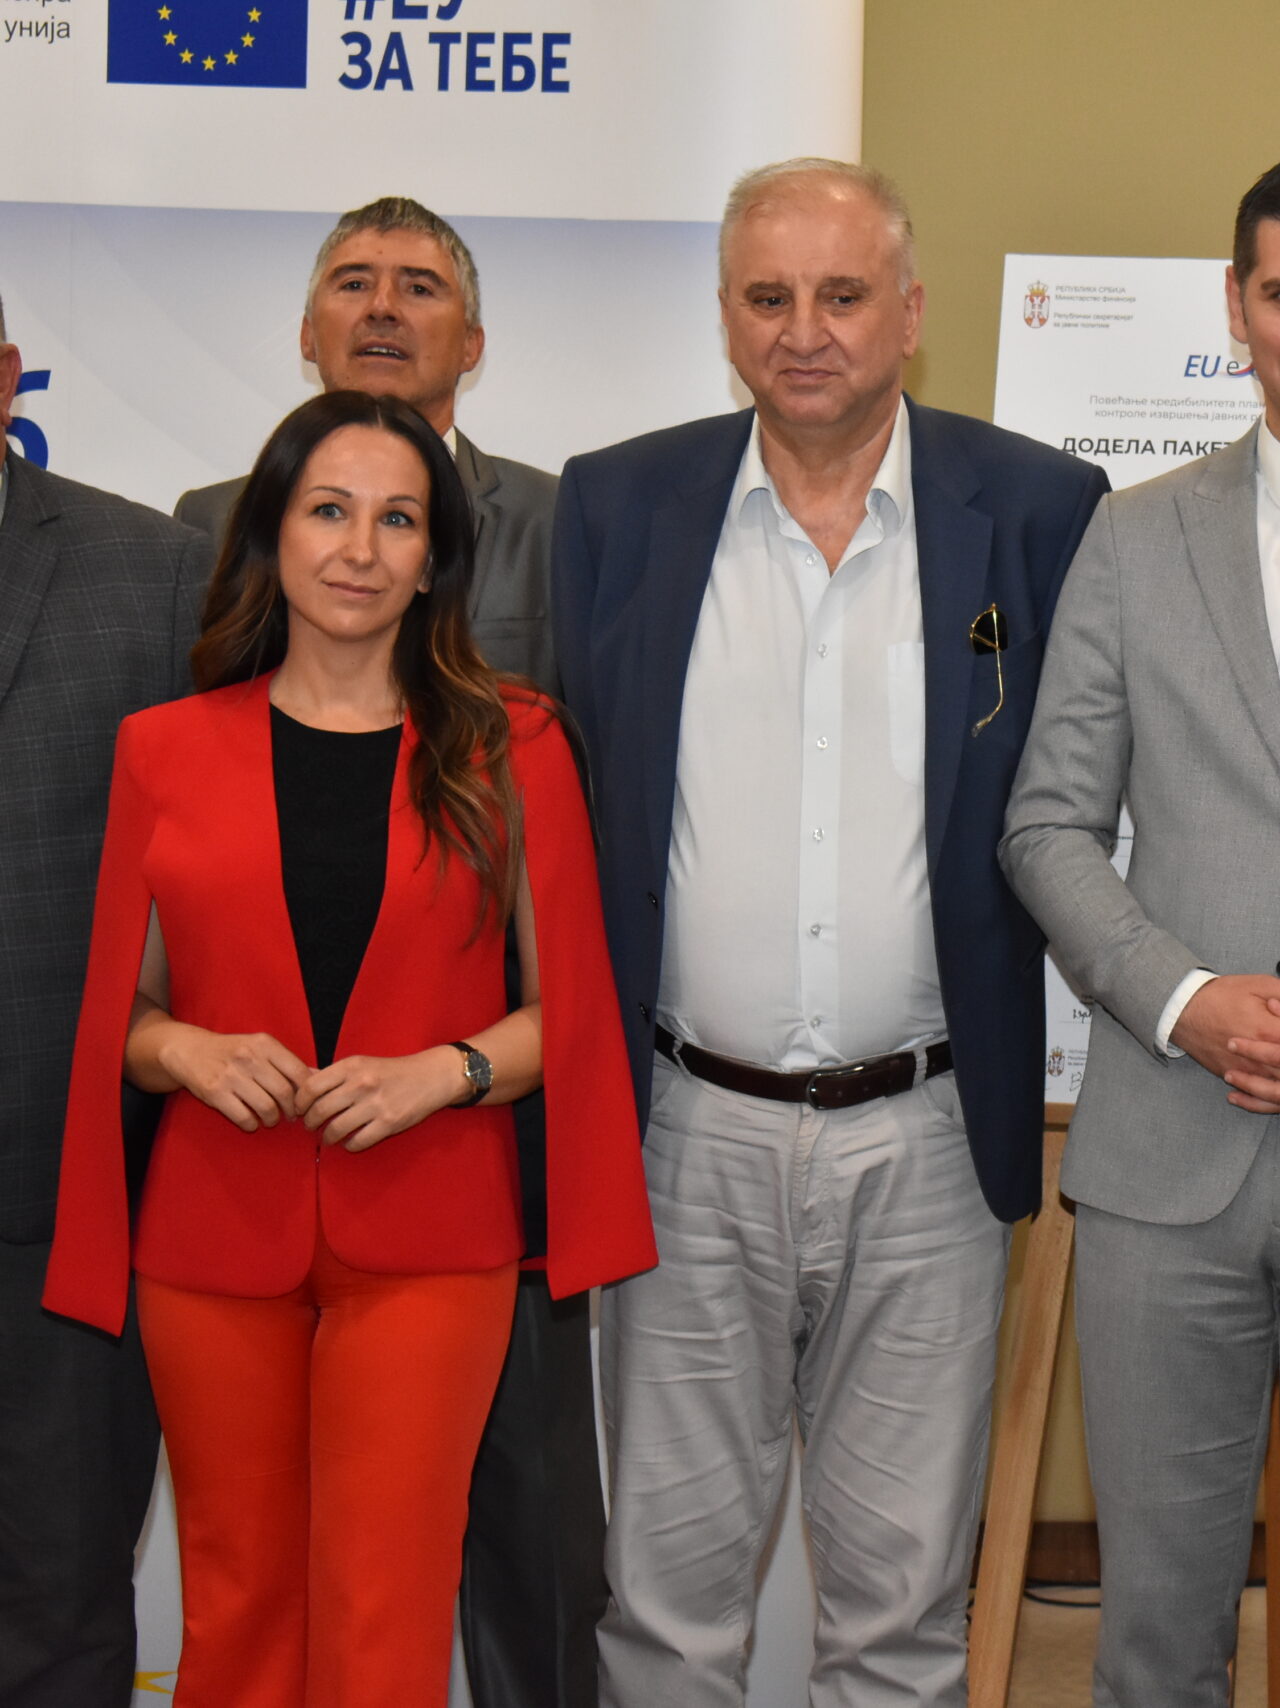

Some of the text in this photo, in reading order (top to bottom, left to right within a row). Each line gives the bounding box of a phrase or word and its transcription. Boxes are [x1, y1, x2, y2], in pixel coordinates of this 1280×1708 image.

[4, 15, 71, 44] унија
[338, 31, 571, 93] ЗА ТЕБЕ
[1184, 354, 1221, 378] EU
[1062, 437, 1156, 456] ДОДЕЛА
